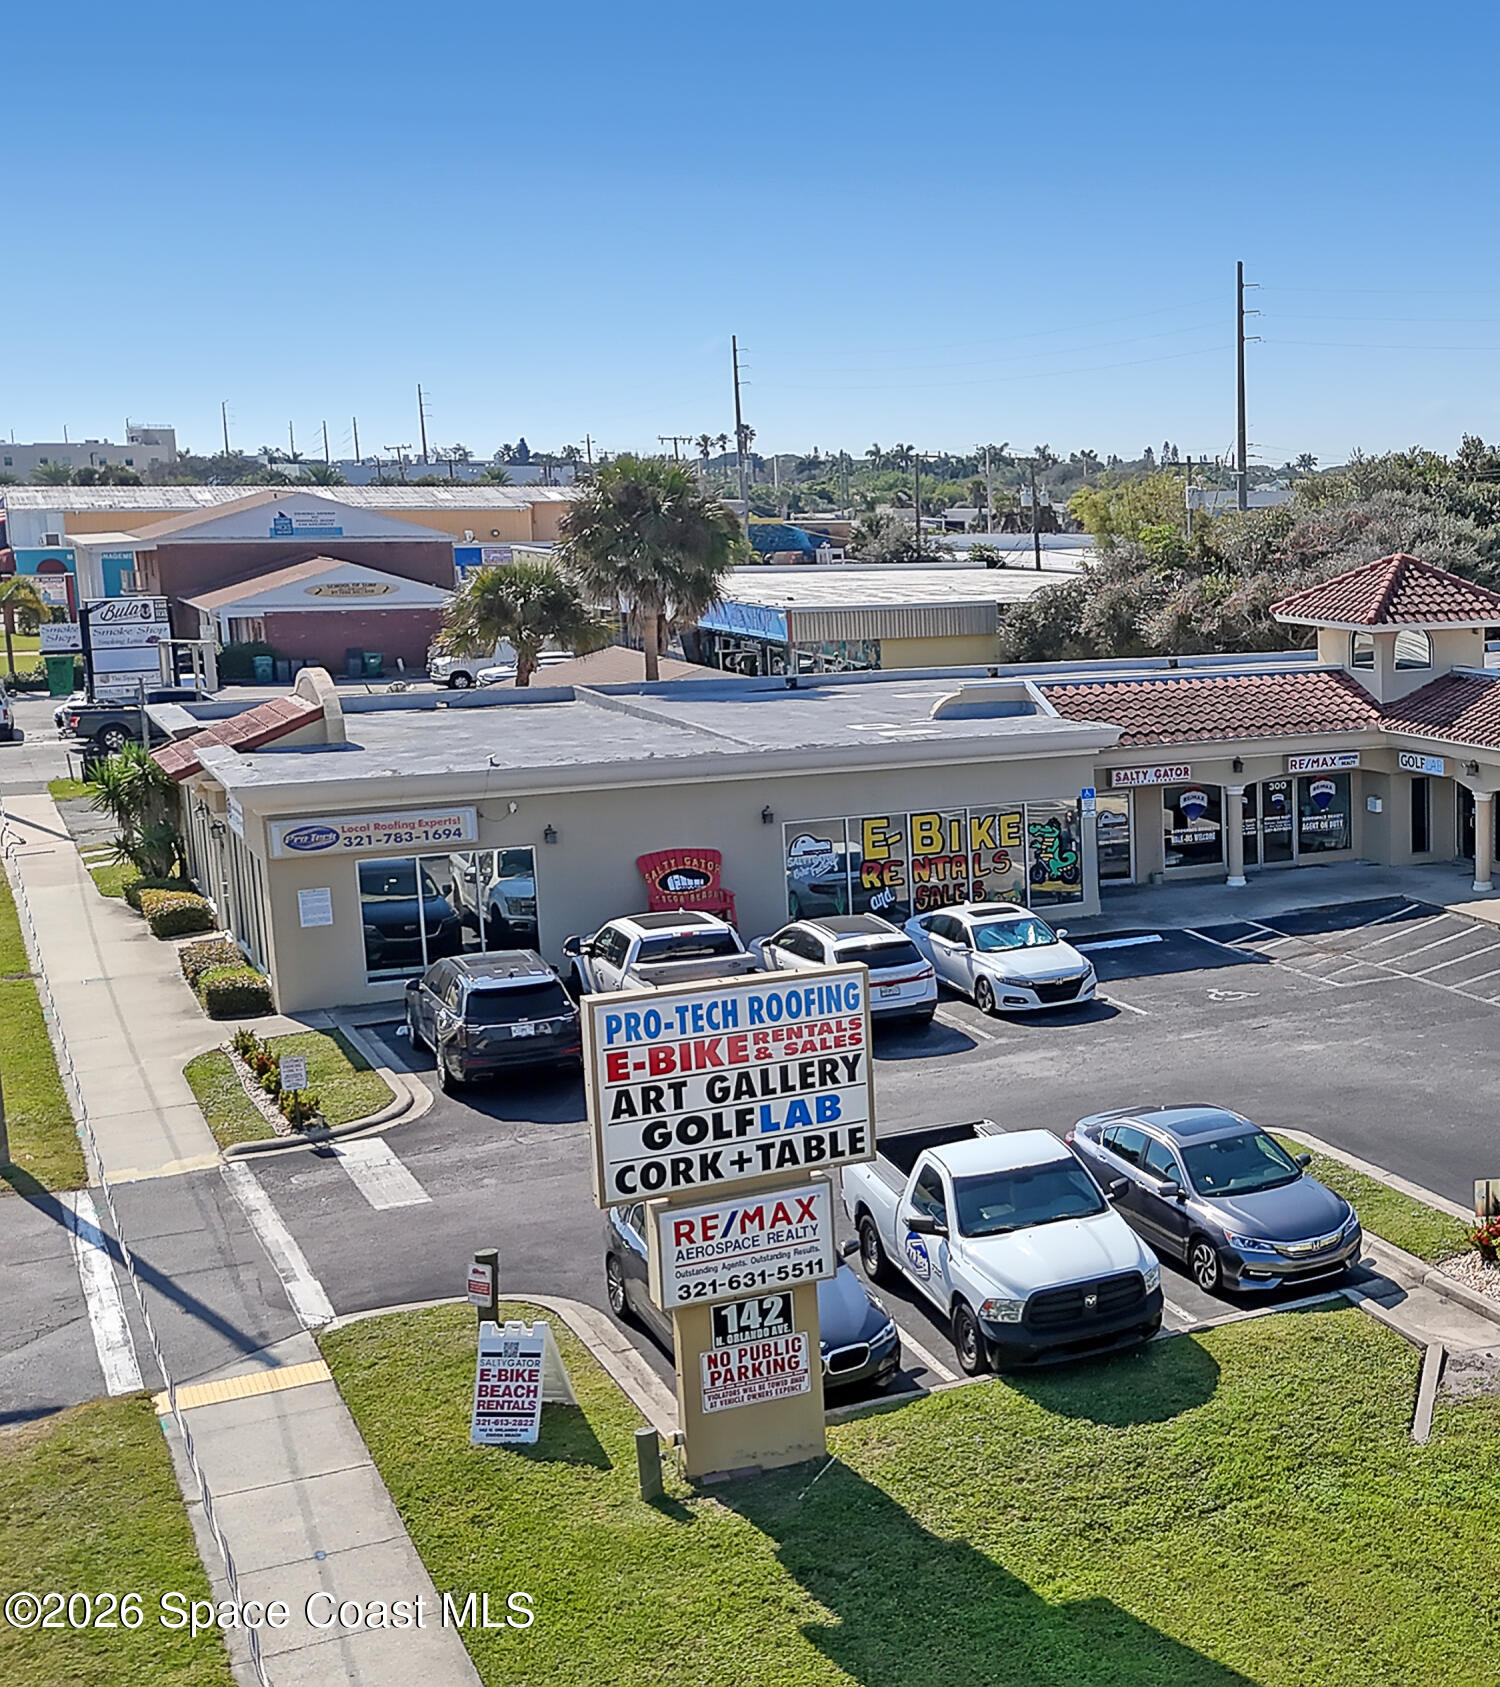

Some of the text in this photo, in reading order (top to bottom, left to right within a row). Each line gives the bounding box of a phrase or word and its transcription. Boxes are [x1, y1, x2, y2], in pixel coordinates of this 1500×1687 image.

[100, 601, 139, 621] Bula
[41, 625, 79, 634] Smoke
[46, 635, 76, 643] Shop
[93, 626, 168, 637] Smoke Shop
[1115, 766, 1190, 782] SALTY GATOR
[1289, 756, 1337, 771] RE/MAX
[1268, 781, 1287, 791] 300
[341, 816, 462, 834] Local Roofing Experts!
[861, 812, 1023, 861] E-BIKE
[343, 827, 463, 848] 321-783-1694
[645, 856, 721, 884] SALTY GATOR
[860, 849, 1012, 889] RENTALS
[869, 887, 896, 911] and
[914, 880, 988, 911] SALES
[605, 981, 861, 1045] PRO-TECH ROOFING
[606, 1017, 863, 1083] E-BIKE RENTALS
[754, 1031, 863, 1060] & SALES
[610, 1053, 862, 1120] ART GALLERY
[672, 1195, 818, 1248] RE/MAX
[675, 1224, 820, 1262] AEROSPACE REALTY
[675, 1262, 719, 1280] Outstanding
[750, 1250, 791, 1266] Outstanding
[677, 1258, 824, 1301] 321-631-5511
[721, 1295, 784, 1334] 142
[727, 1327, 770, 1345] ORLANDO
[771, 1323, 791, 1336] AVE.
[707, 1336, 802, 1371] NO PUBLIC
[479, 1368, 540, 1383] E-BIKE
[709, 1354, 801, 1386] PARKING
[477, 1384, 538, 1399] BEACH
[707, 1388, 741, 1402] VIOLATORS
[742, 1384, 757, 1396] WILL
[758, 1382, 766, 1391] BE
[767, 1378, 788, 1390] TOWED
[709, 1399, 718, 1409] AT
[719, 1394, 745, 1407] VEHICLE
[746, 1389, 773, 1401] OWNERS
[476, 1400, 537, 1411] RENTALS
